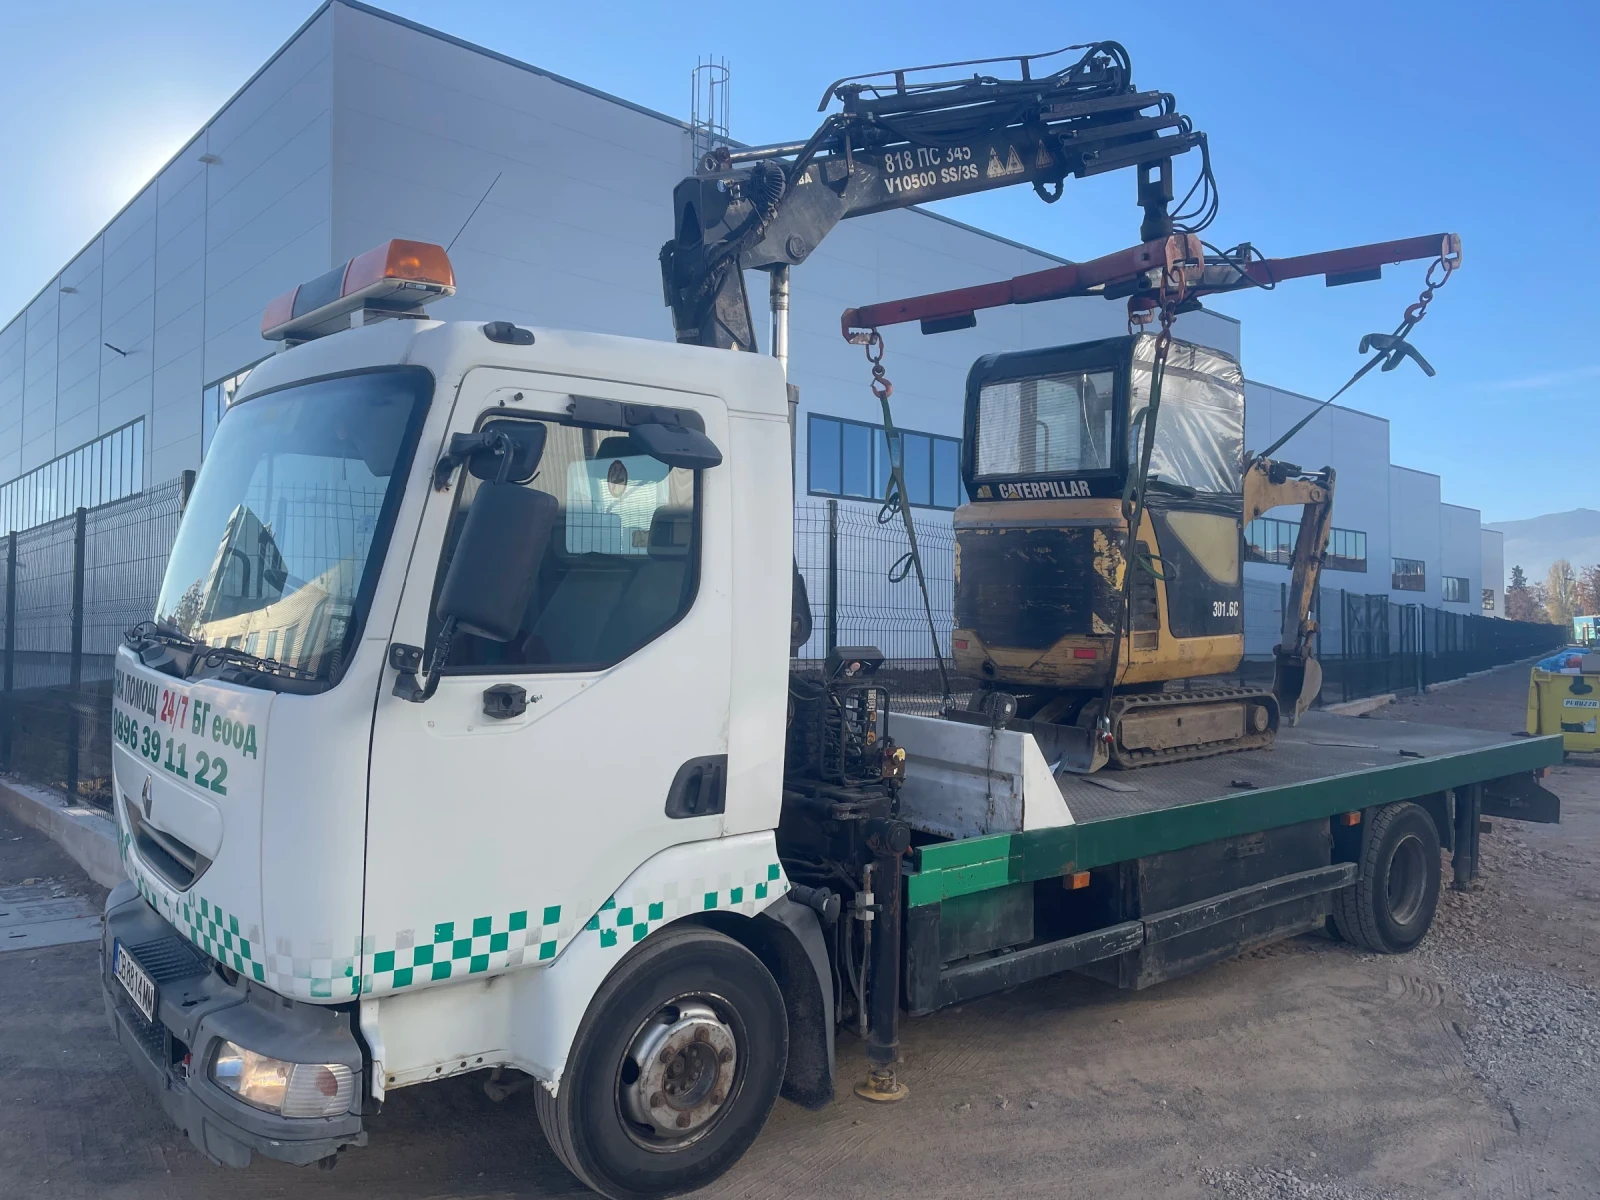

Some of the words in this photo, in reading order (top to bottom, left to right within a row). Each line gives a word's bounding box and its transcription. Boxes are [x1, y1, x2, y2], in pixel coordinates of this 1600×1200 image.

[884, 150, 914, 174] 818
[916, 147, 941, 168] ПС
[946, 146, 971, 163] 345
[884, 170, 937, 194] V10500
[940, 163, 979, 184] SS/3S
[998, 480, 1092, 499] CATERPILLAR
[1212, 600, 1239, 617] 301.6C
[125, 674, 159, 724] ПОМОЩ
[160, 689, 189, 733] 24/7
[191, 699, 211, 737] БГ
[113, 707, 139, 750] 0896
[141, 725, 161, 762] 39
[164, 737, 188, 779] 11
[194, 750, 228, 796] 22
